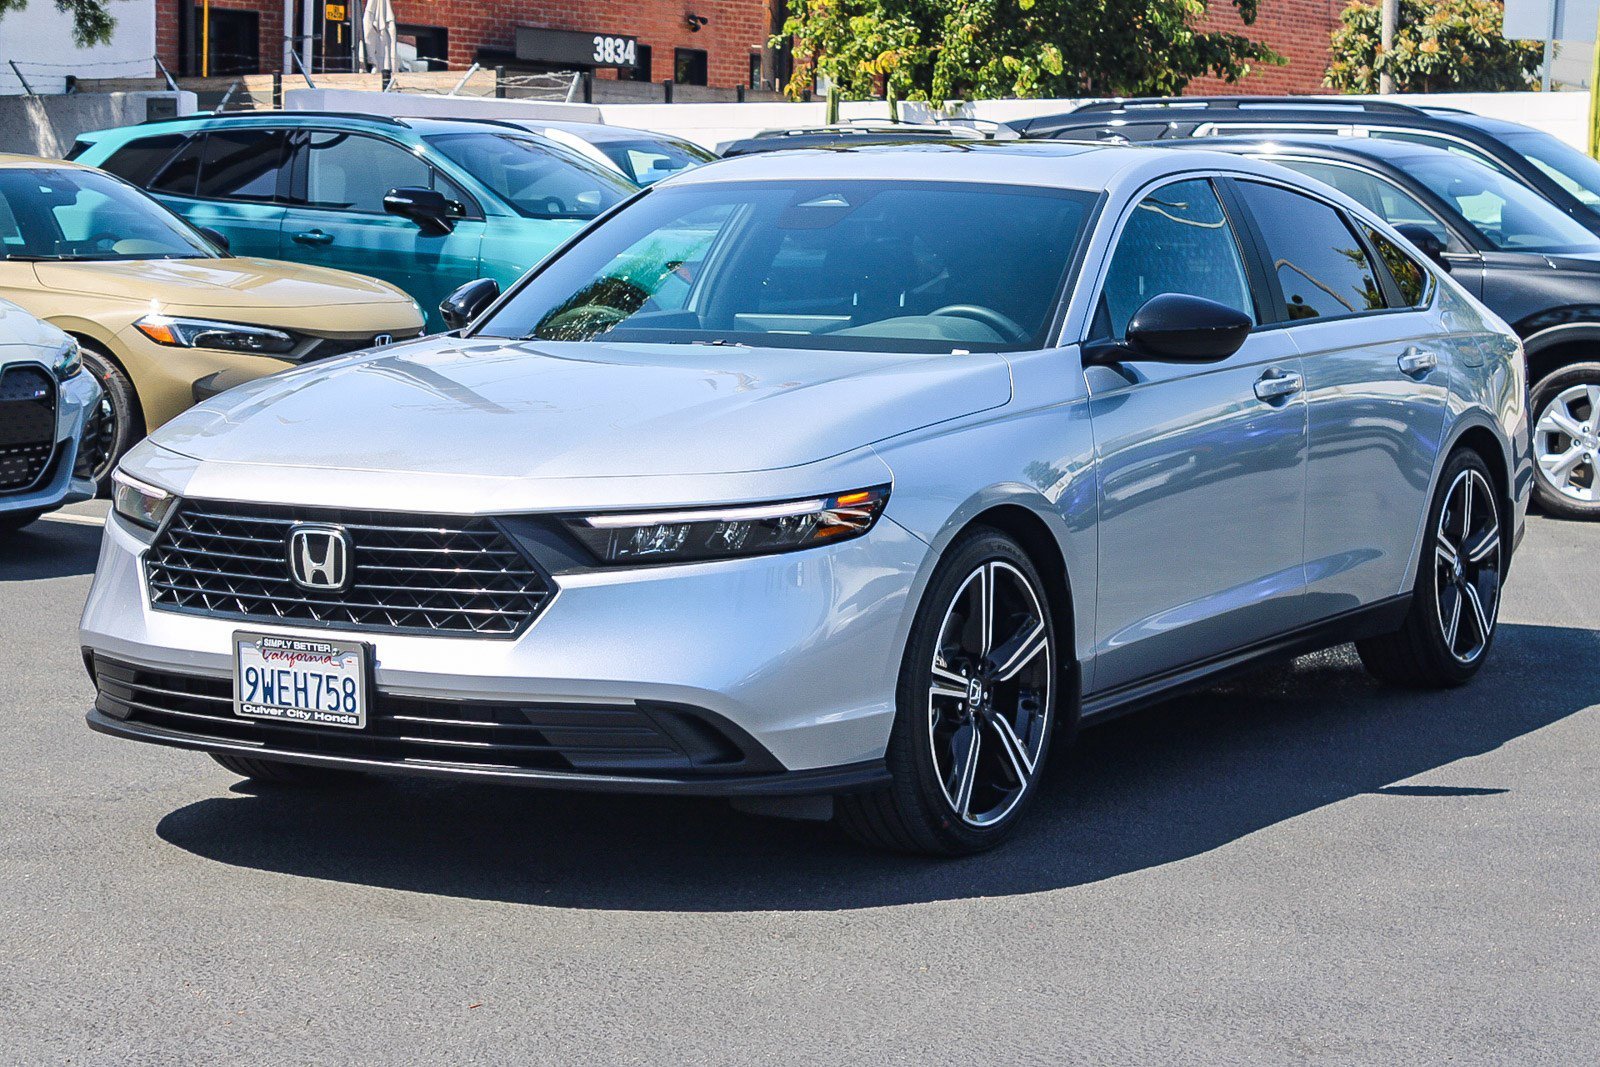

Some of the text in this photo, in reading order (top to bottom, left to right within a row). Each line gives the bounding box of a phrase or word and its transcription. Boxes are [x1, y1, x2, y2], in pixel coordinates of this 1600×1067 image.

[593, 36, 635, 65] 3834
[263, 638, 331, 653] SIMPLY BETTER
[245, 666, 357, 714] 9WEH758
[242, 704, 357, 724] Culver City Honda
